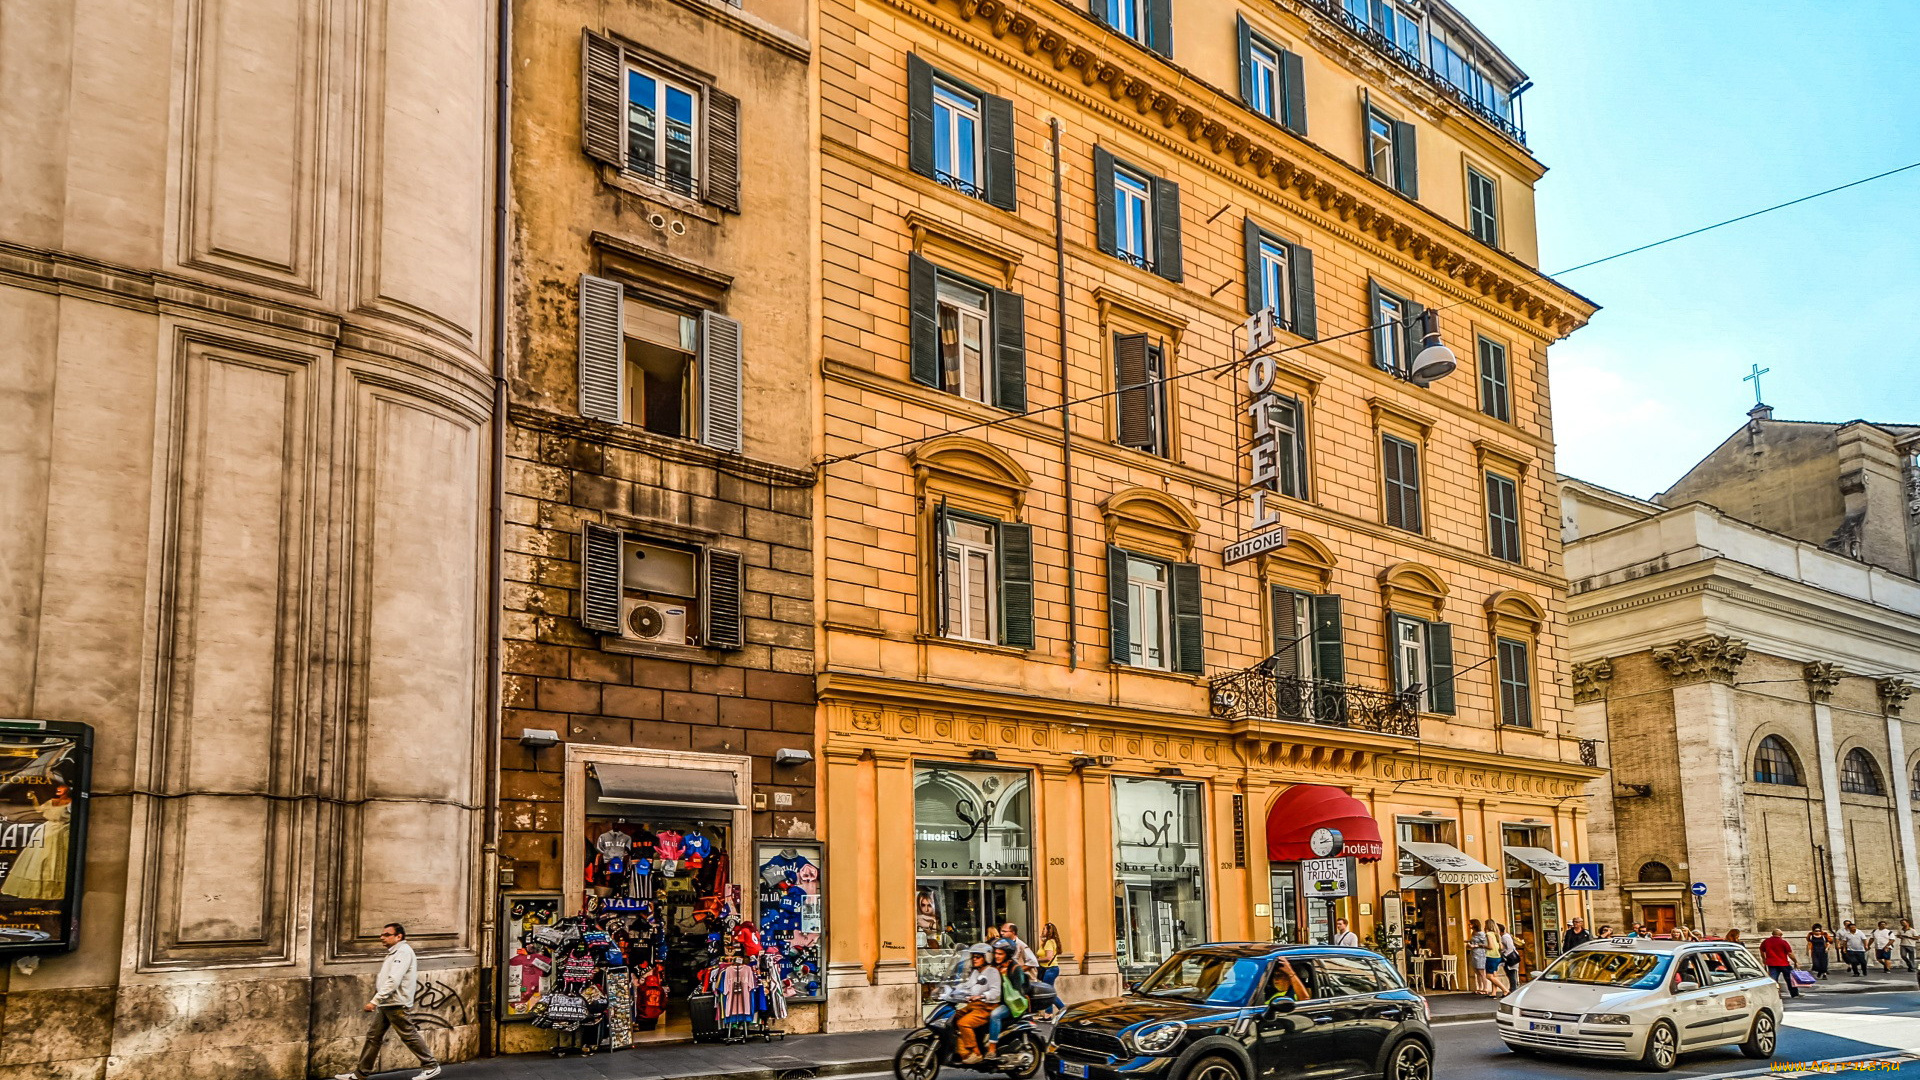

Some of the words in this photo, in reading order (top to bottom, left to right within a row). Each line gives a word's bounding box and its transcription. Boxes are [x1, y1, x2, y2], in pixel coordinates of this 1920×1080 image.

[1244, 304, 1281, 531] HOTEL
[1225, 531, 1281, 563] TRITONE
[775, 793, 791, 804] 207
[1342, 843, 1369, 854] hotel
[920, 858, 959, 869] Shoe
[968, 860, 1027, 870] fashion
[1049, 857, 1065, 866] 208
[1303, 860, 1338, 871] HOTEL
[1115, 862, 1146, 872] Shoe
[1153, 863, 1199, 873] fashion
[1307, 870, 1344, 880] TRITONE
[1460, 873, 1466, 883] &
